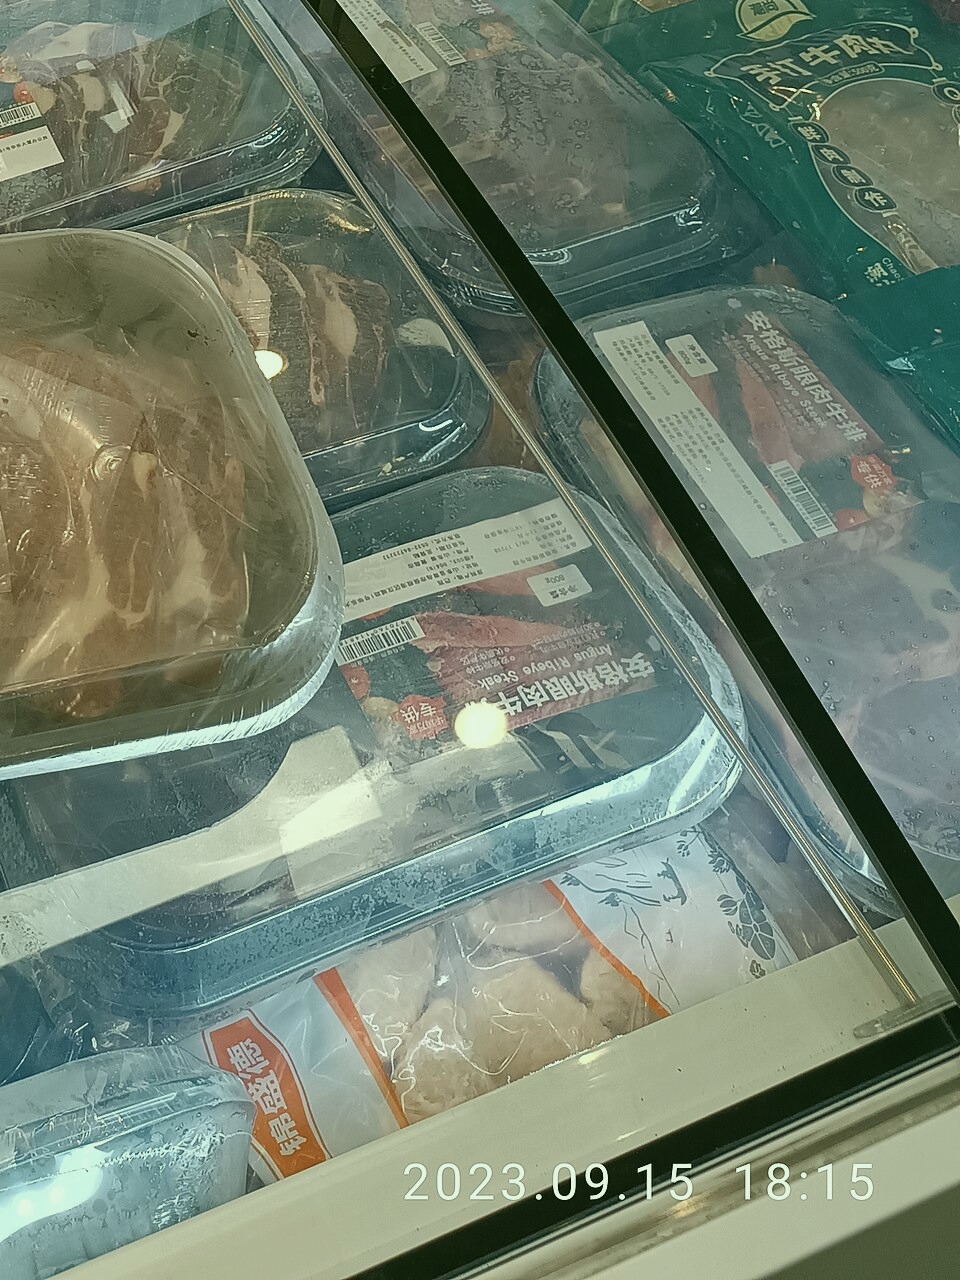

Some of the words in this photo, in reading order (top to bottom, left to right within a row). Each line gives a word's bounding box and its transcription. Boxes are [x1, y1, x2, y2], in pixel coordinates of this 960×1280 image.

[744, 310, 868, 442] 安格斯眼肉牛排
[573, 643, 613, 662] Angus
[522, 655, 572, 676] Ribeye
[464, 651, 655, 717] 安格斯眼肉牛
[477, 671, 520, 691] Steak
[399, 702, 437, 724] 专供
